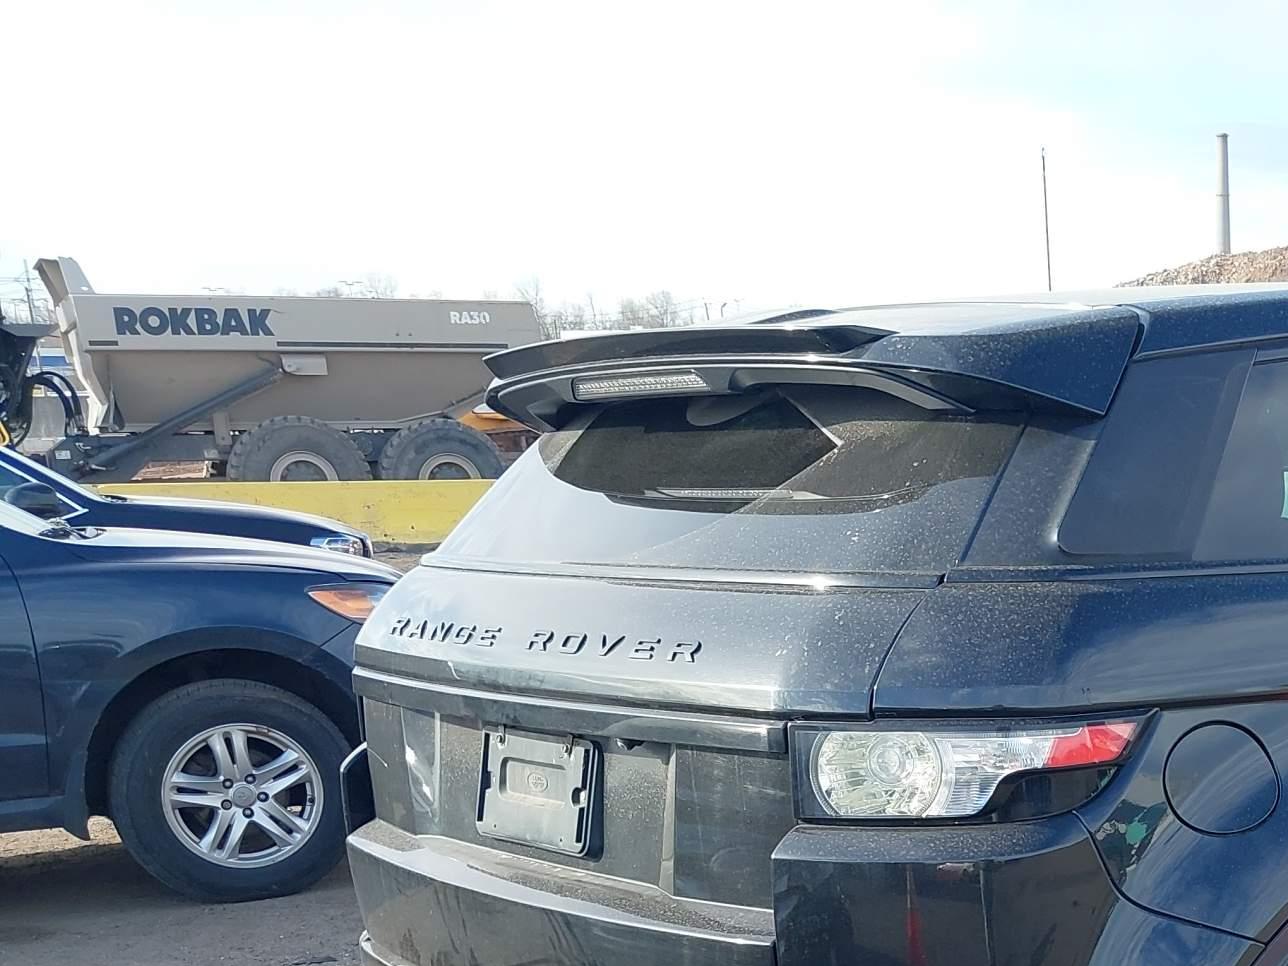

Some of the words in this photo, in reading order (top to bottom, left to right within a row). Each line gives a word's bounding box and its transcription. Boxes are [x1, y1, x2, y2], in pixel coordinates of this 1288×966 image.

[112, 306, 275, 336] ROKBAK
[449, 311, 490, 324] RA30
[389, 616, 502, 648] RANGE
[526, 630, 704, 663] ROVER
